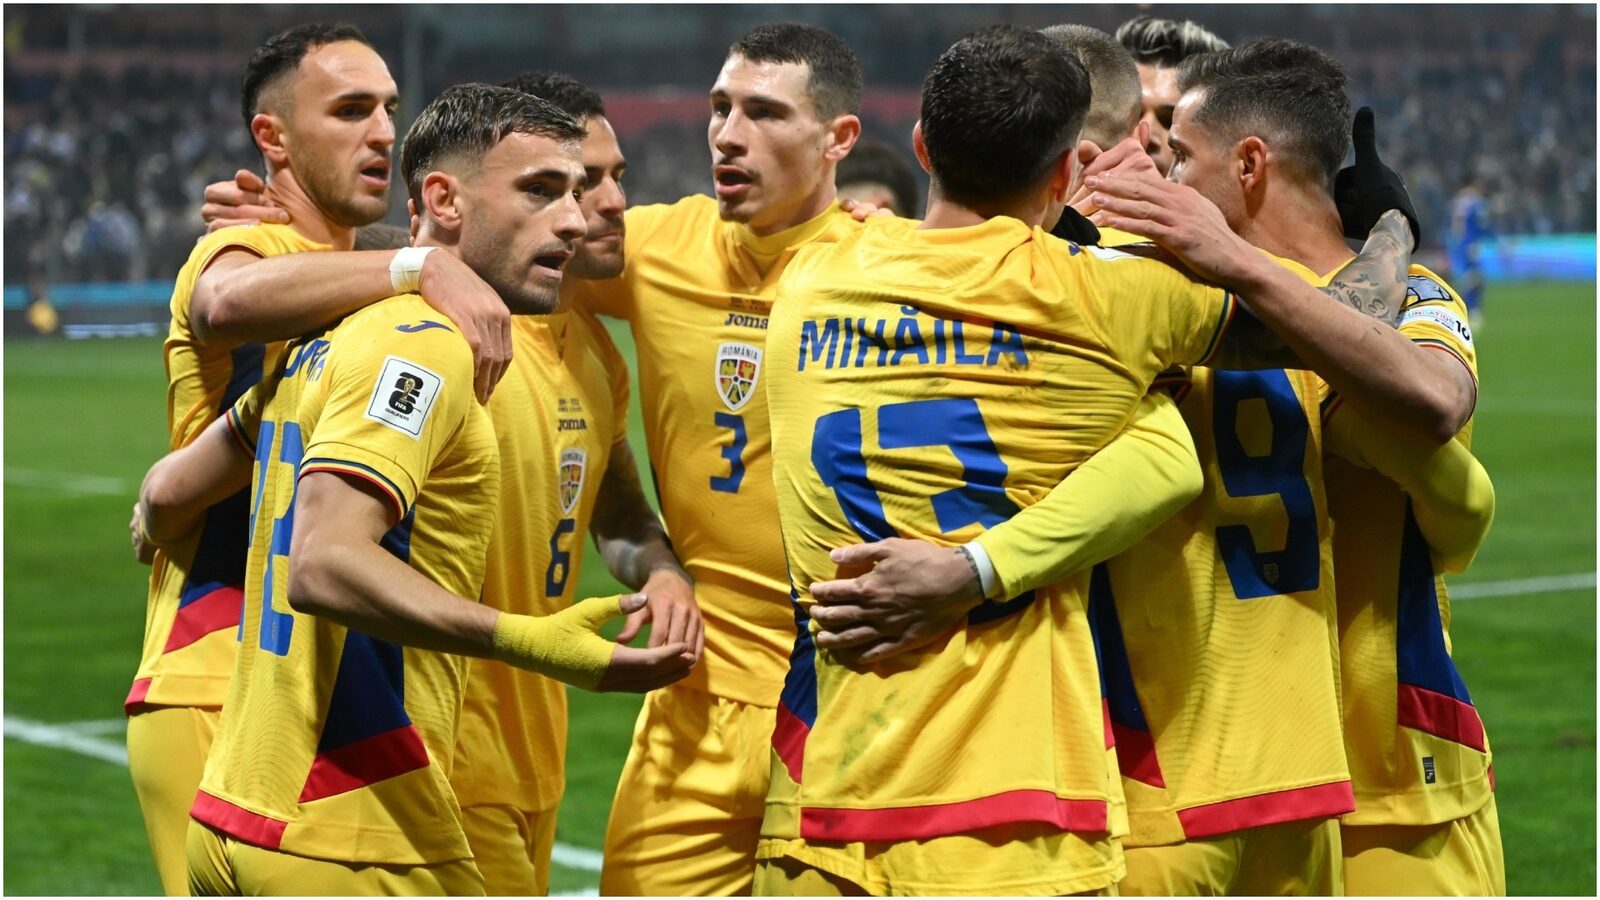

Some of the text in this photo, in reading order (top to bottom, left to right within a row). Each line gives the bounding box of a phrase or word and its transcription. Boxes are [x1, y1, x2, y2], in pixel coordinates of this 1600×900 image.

[721, 346, 758, 360] ROMÂNIA
[798, 305, 1030, 371] MIHĂILA
[384, 407, 410, 422] QUALIFIERS
[394, 401, 407, 411] FIFA
[710, 411, 748, 494] 3
[1212, 368, 1320, 600] 9
[545, 518, 575, 598] 6
